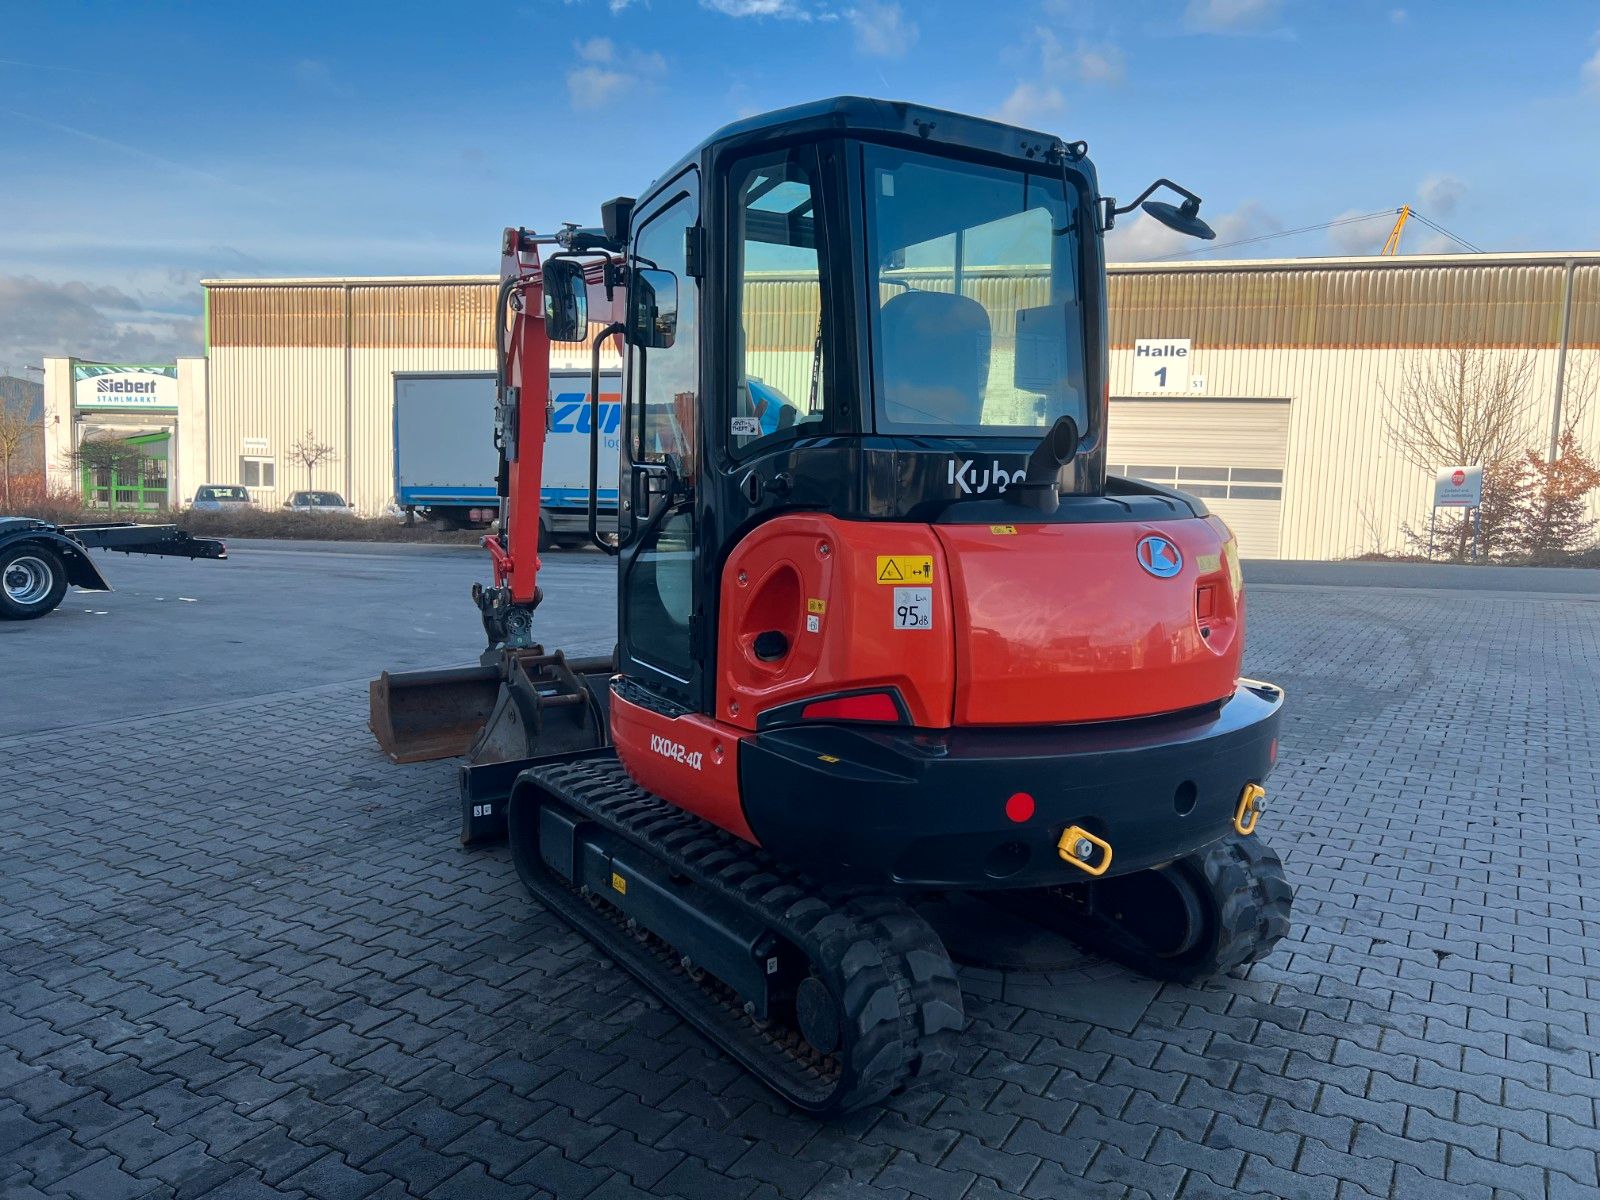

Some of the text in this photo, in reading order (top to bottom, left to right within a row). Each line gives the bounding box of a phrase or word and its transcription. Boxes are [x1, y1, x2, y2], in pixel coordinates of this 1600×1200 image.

[1136, 344, 1188, 357] Halle
[1154, 366, 1167, 387] 1
[97, 379, 156, 393] Siebert
